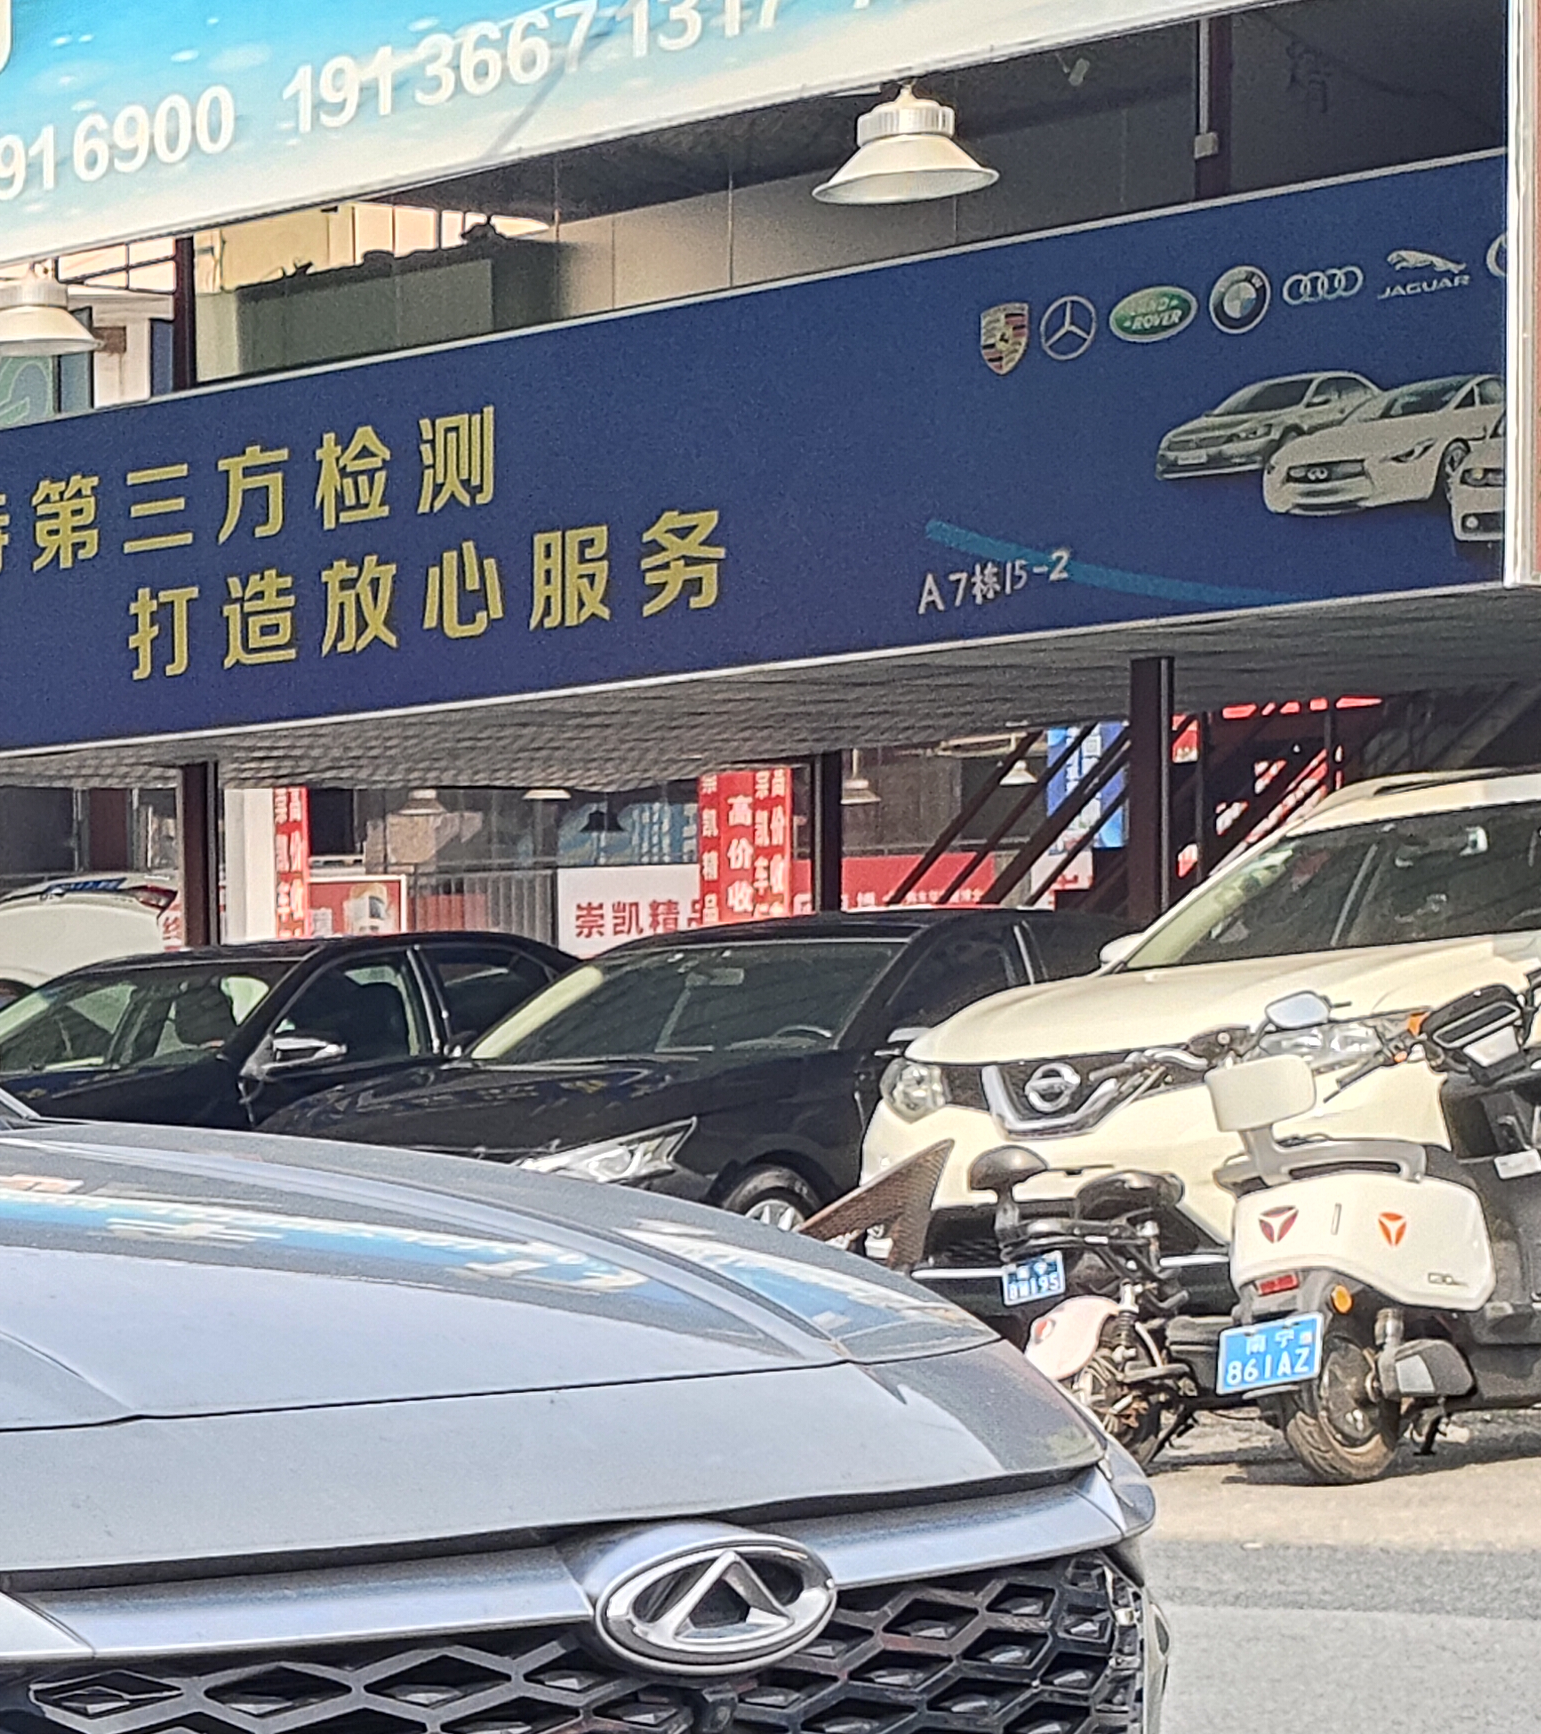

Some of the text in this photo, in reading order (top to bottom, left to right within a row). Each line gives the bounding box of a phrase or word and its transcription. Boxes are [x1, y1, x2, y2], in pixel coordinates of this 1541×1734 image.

[1377, 274, 1471, 301] JAGUAR
[127, 508, 728, 682] 打造放心服务
[1225, 1346, 1311, 1387] 861AZ
